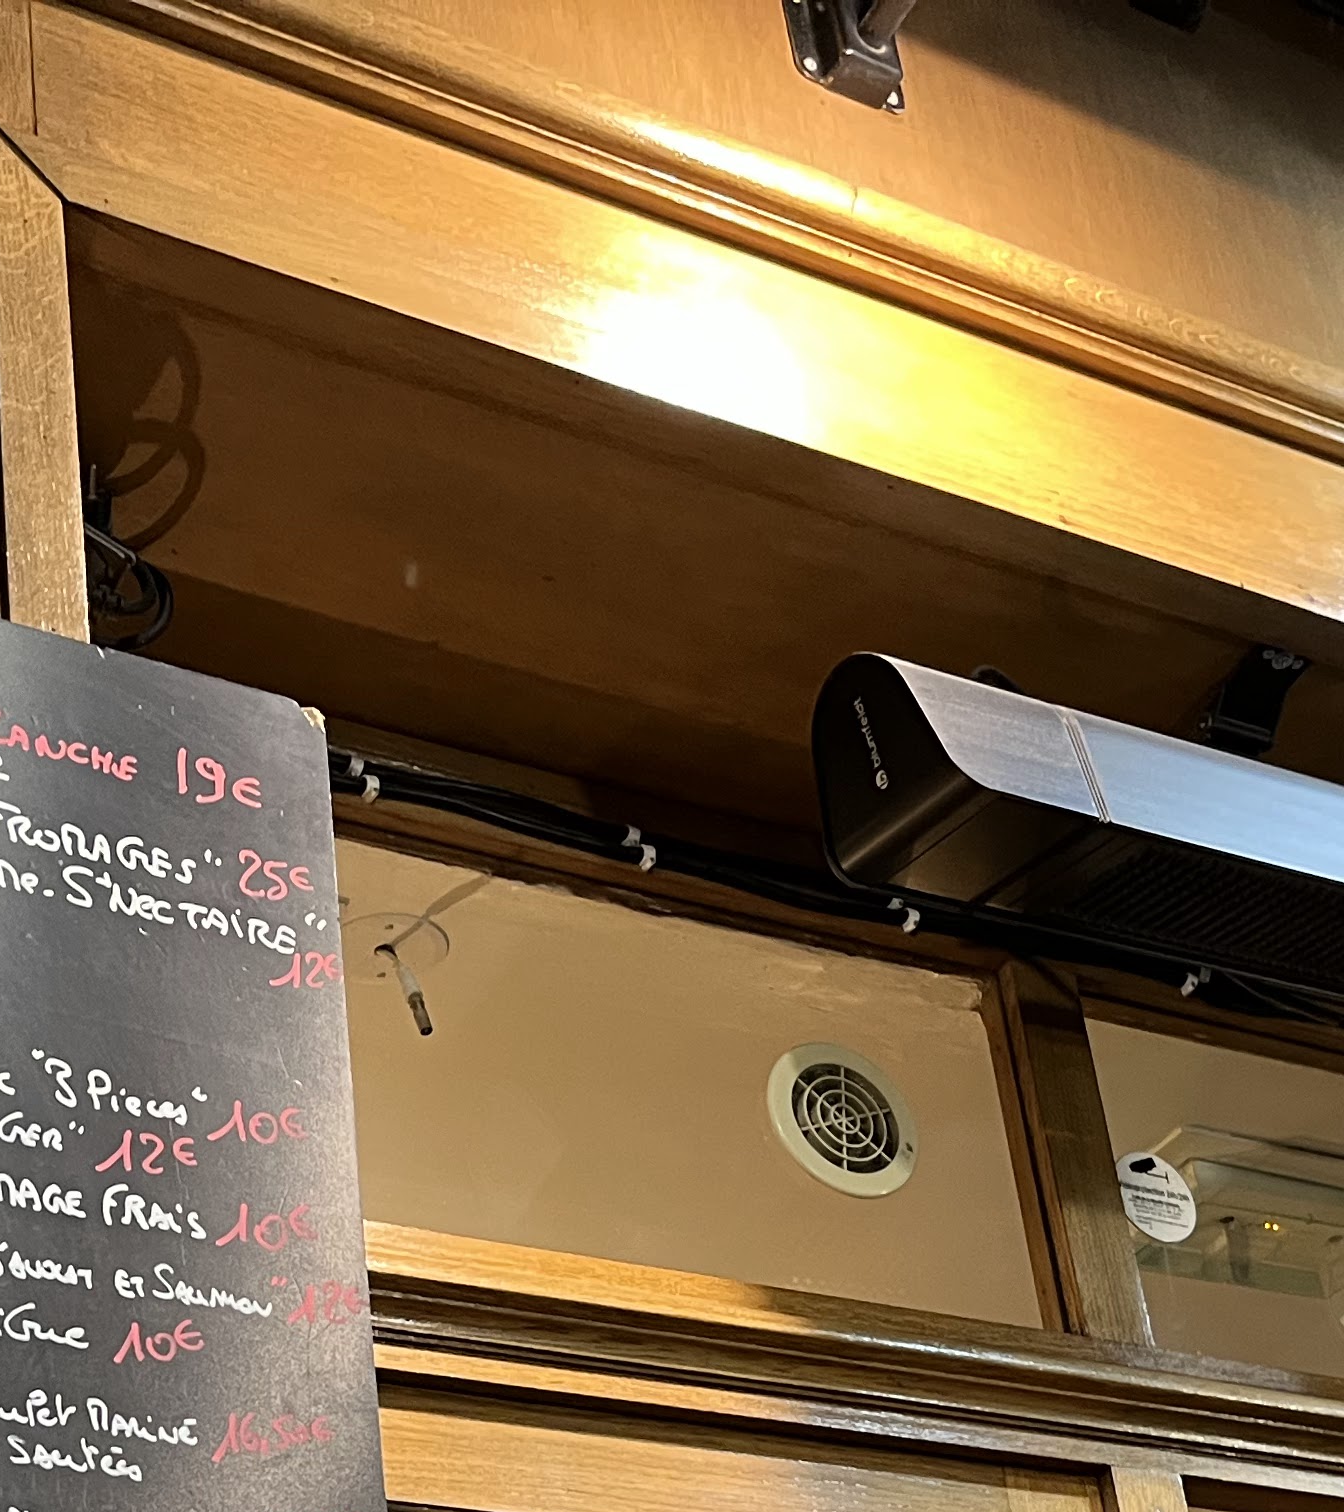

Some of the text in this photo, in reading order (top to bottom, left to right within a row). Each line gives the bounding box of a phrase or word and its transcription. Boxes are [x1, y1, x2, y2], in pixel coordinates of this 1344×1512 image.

[176, 748, 262, 808] 19€
[238, 849, 314, 901] 25€
[207, 1101, 307, 1145] 10€
[94, 1130, 198, 1174] 12€
[113, 1319, 205, 1364] 10€
